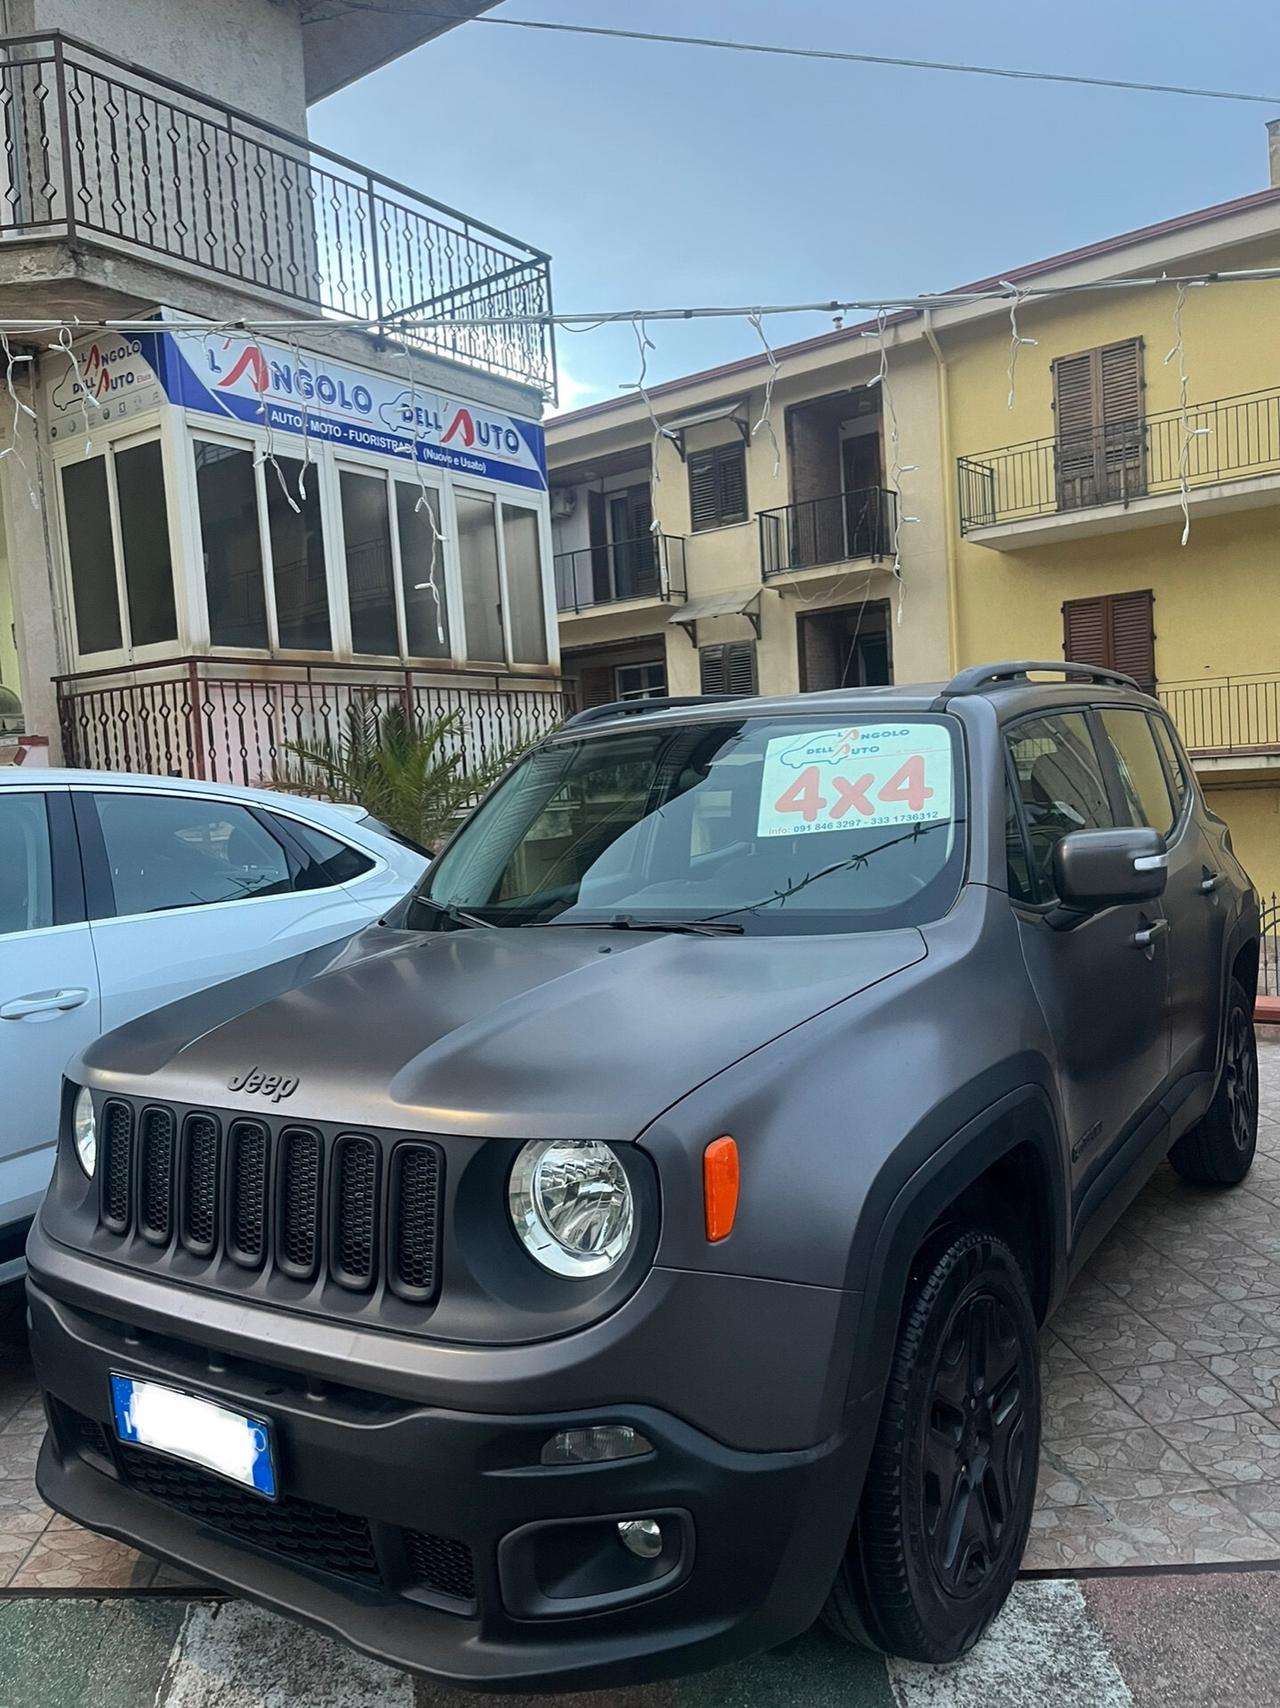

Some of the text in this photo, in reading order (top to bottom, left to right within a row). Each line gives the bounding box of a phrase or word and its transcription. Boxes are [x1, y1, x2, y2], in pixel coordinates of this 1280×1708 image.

[271, 410, 303, 428] AUTO
[311, 420, 342, 437] MOTO
[402, 402, 520, 454] DELL'AUTO
[423, 448, 453, 464] (Nuovo
[460, 458, 487, 474] Usato)
[793, 825, 812, 833] 091
[814, 822, 834, 831] 846
[836, 820, 861, 829] 3297
[871, 816, 889, 825] 333
[893, 811, 938, 823] 1736312
[227, 1065, 300, 1103] Jeep
